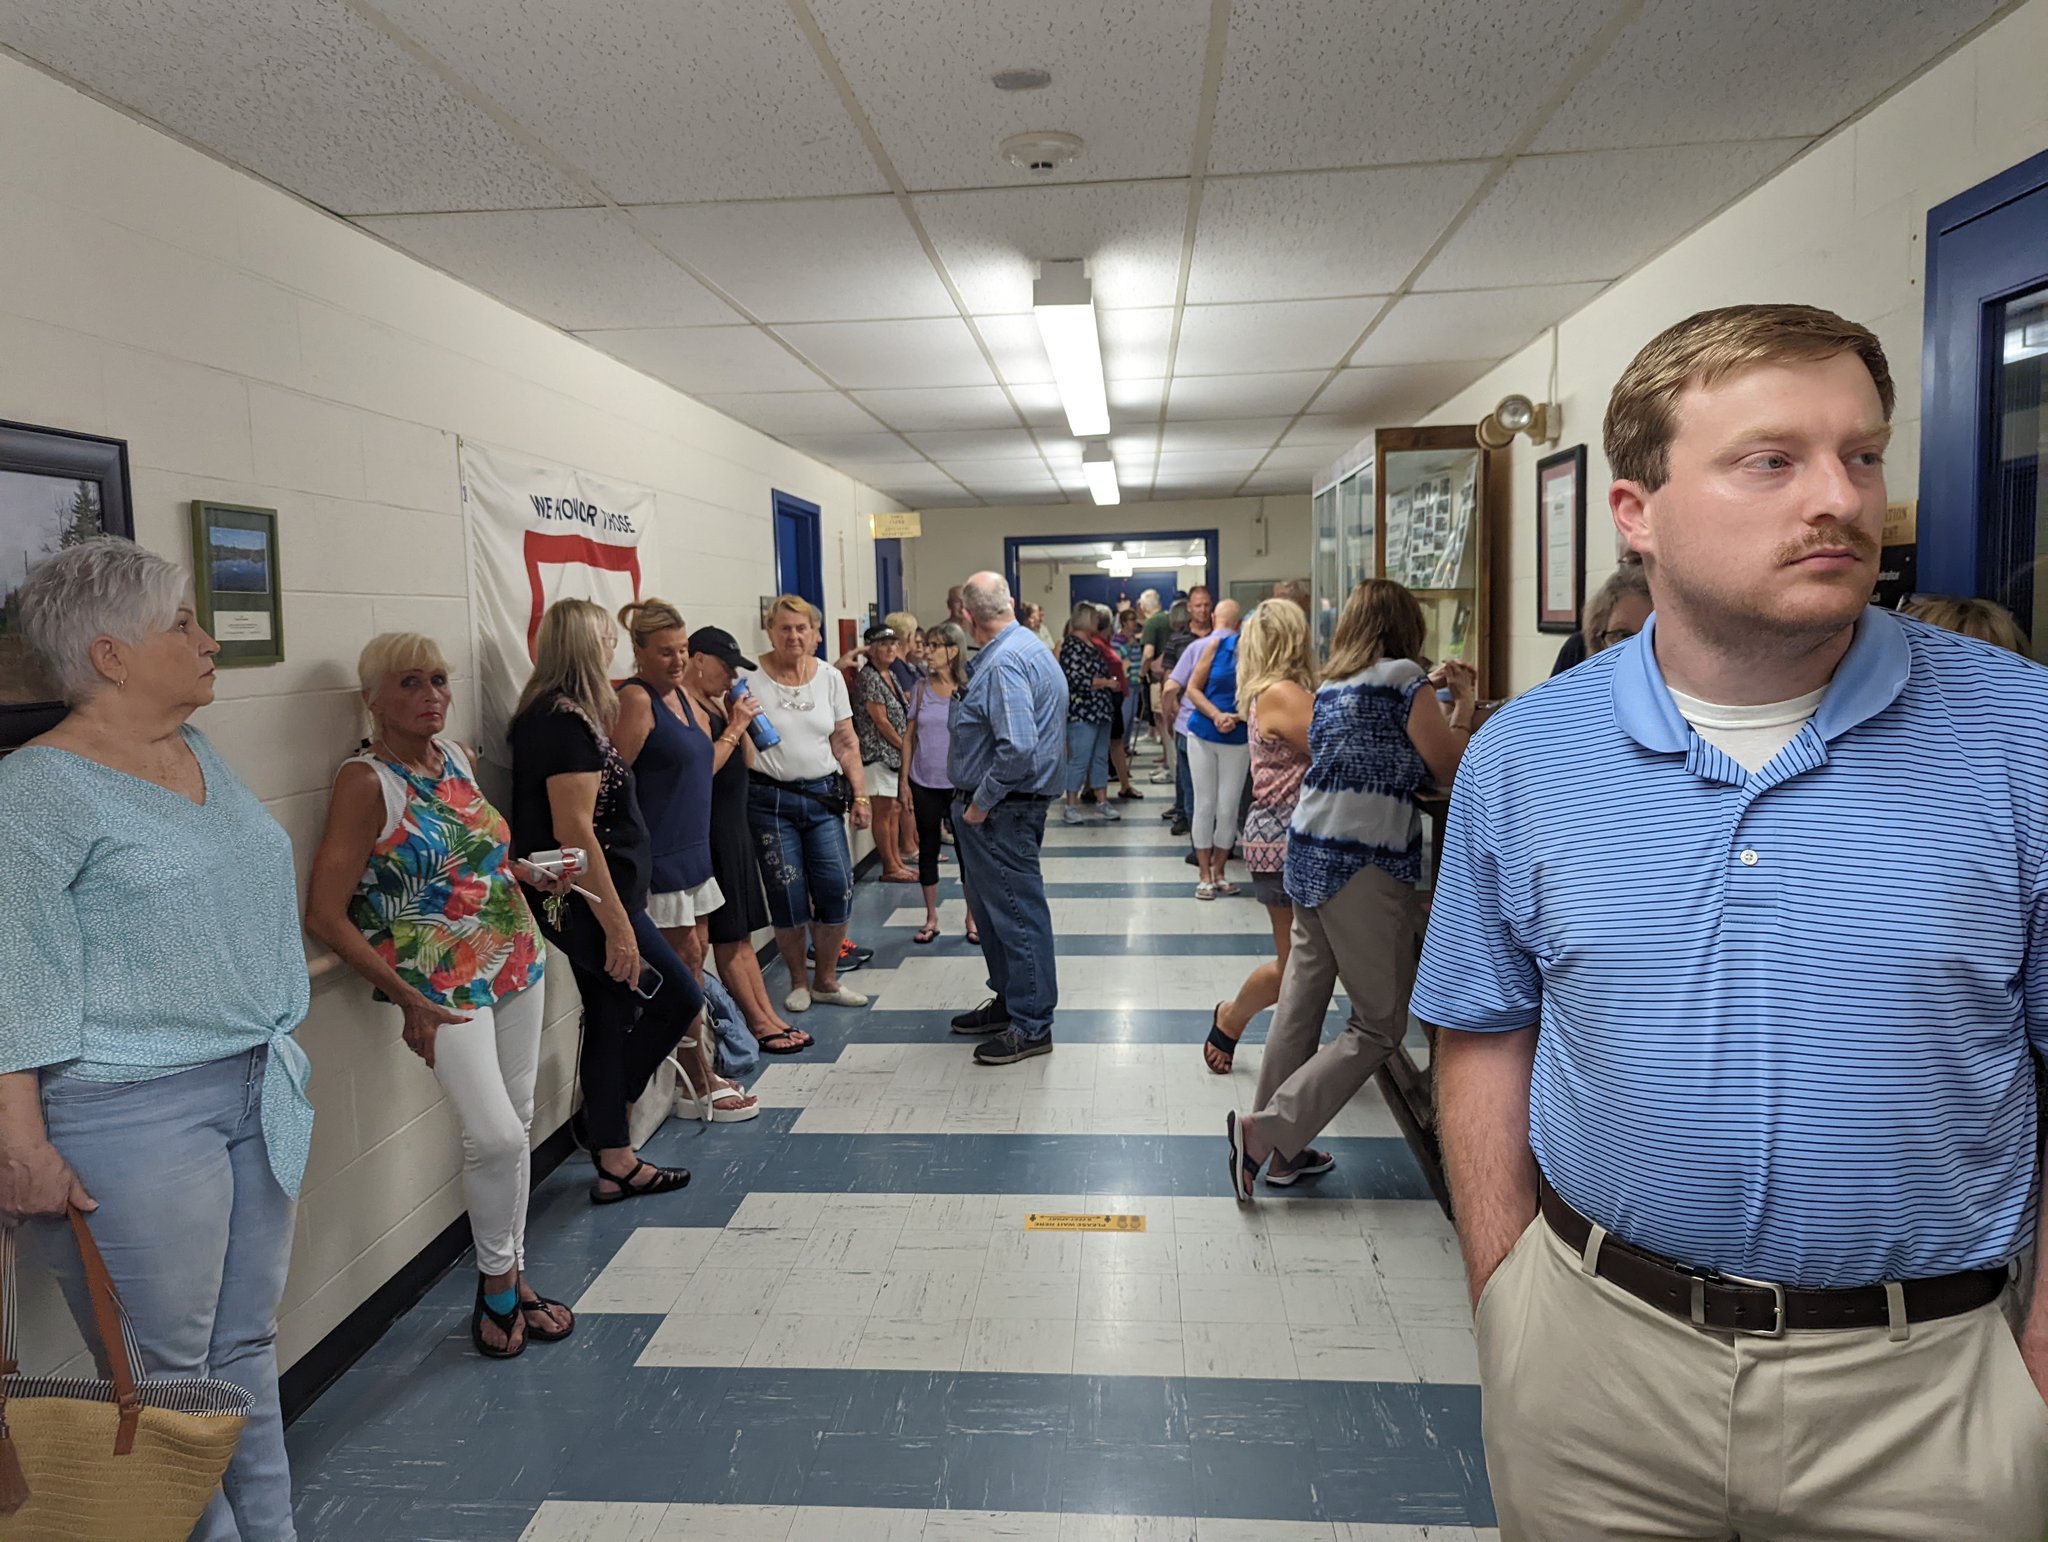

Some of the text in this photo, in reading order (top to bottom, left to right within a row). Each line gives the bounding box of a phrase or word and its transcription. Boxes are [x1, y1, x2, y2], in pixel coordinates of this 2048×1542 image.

[529, 494, 636, 533] WE HONOR THOSE
